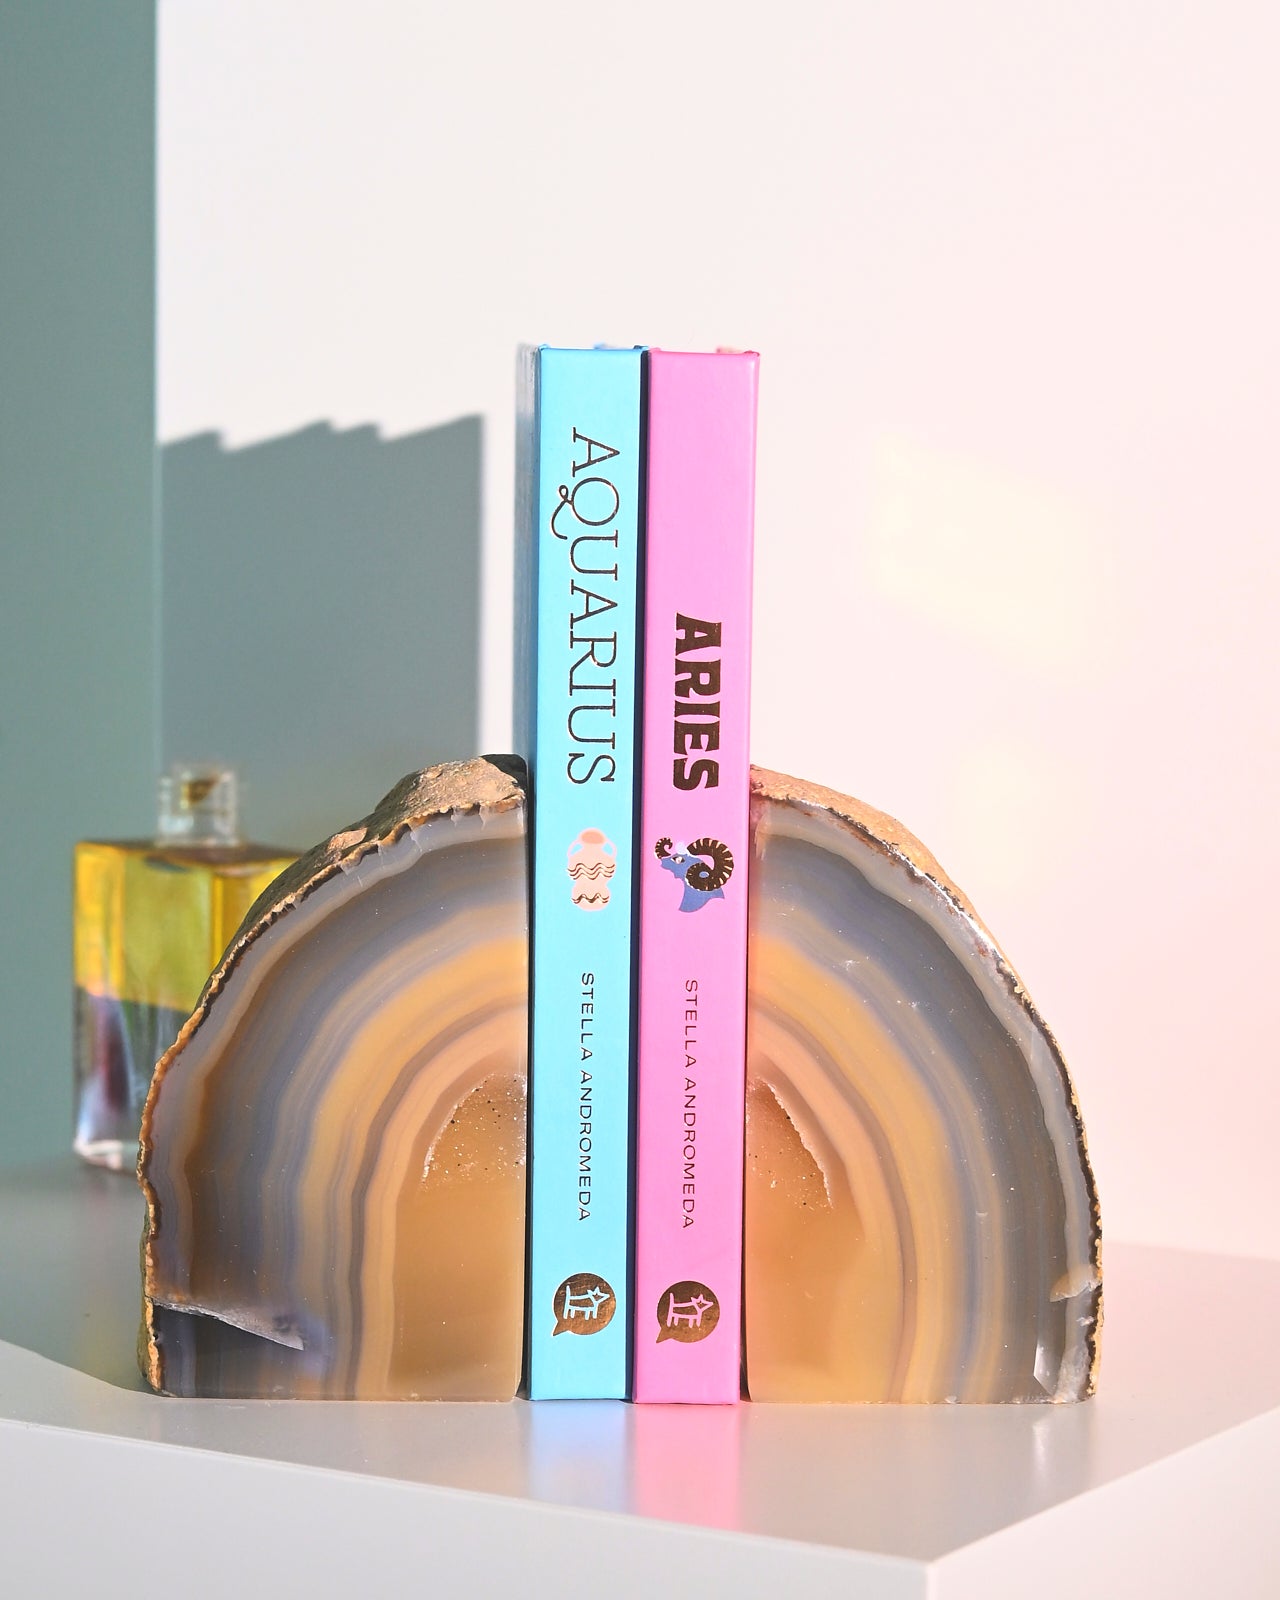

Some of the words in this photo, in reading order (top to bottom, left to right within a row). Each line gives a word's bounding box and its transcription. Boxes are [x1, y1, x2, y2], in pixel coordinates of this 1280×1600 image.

[551, 427, 620, 784] AQUARIUS
[673, 612, 722, 791] ARIES
[580, 972, 595, 1062] STELLA
[684, 979, 699, 1069] STELLA
[578, 1069, 593, 1222] ANDROMEDA
[682, 1077, 697, 1229] ANDROMEDA
